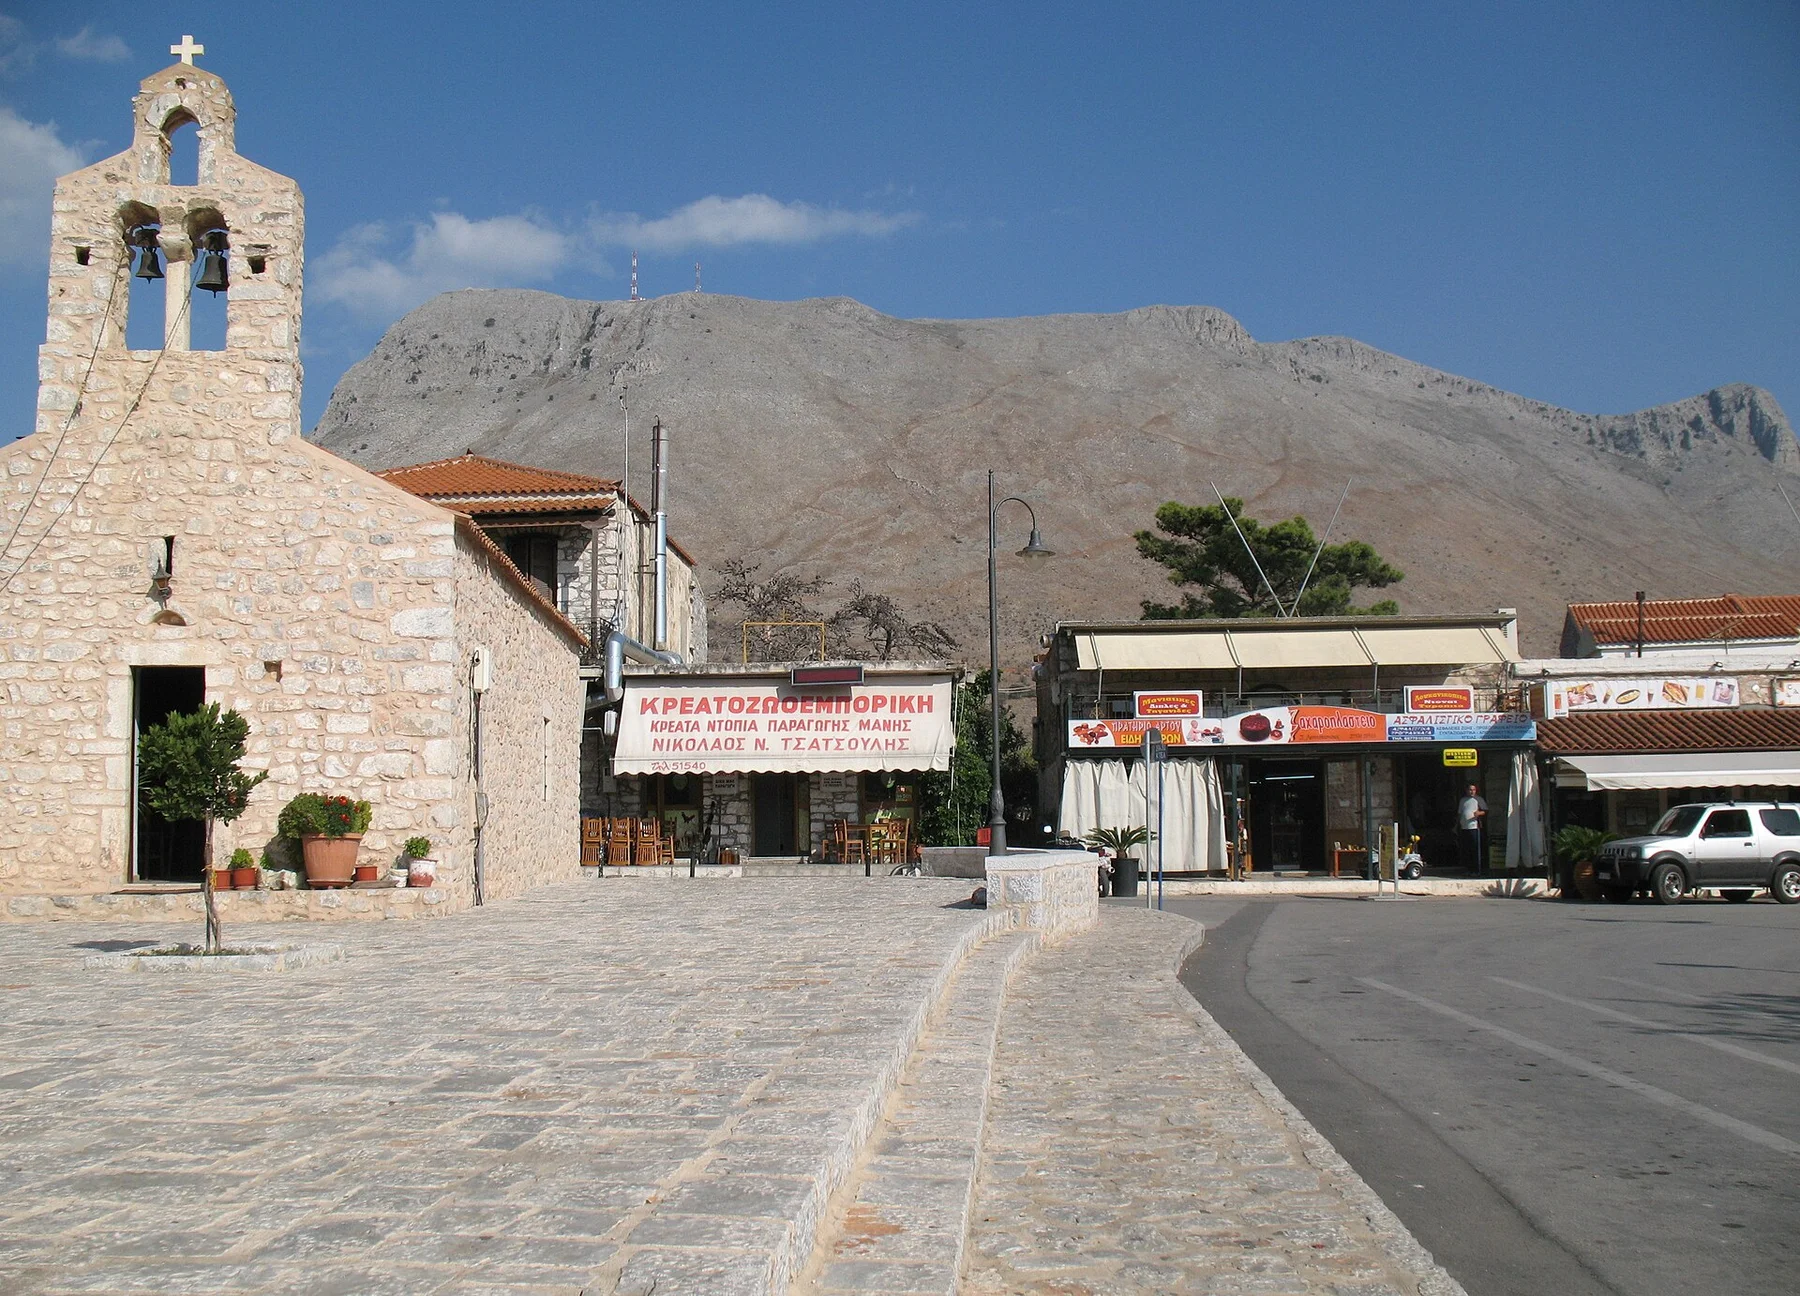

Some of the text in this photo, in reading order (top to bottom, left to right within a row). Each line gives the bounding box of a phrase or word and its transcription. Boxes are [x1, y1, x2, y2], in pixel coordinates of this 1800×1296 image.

[640, 694, 933, 716] ΚΡΕΑΤΟΖΩΟΕΜΠΟΡΙΚΗ
[1475, 713, 1528, 724] ΓΡΑΦΕΙΟ
[650, 719, 911, 733] ΚΡΕΑΤΑ ΝΤΟΠΙΑ ΠΑΡΑΓΩΓΗΣ ΜΑΝΗΣ
[1112, 720, 1152, 732] ΠΡΑΤΗΡΙΟ
[652, 737, 910, 752] ΝΙΚΟΛΑΟΣ Ν. ΤΣΑΤΣΟΥΛΗΣ
[1121, 734, 1142, 744] ΕΙΔΗ
[671, 761, 706, 770] 51540
